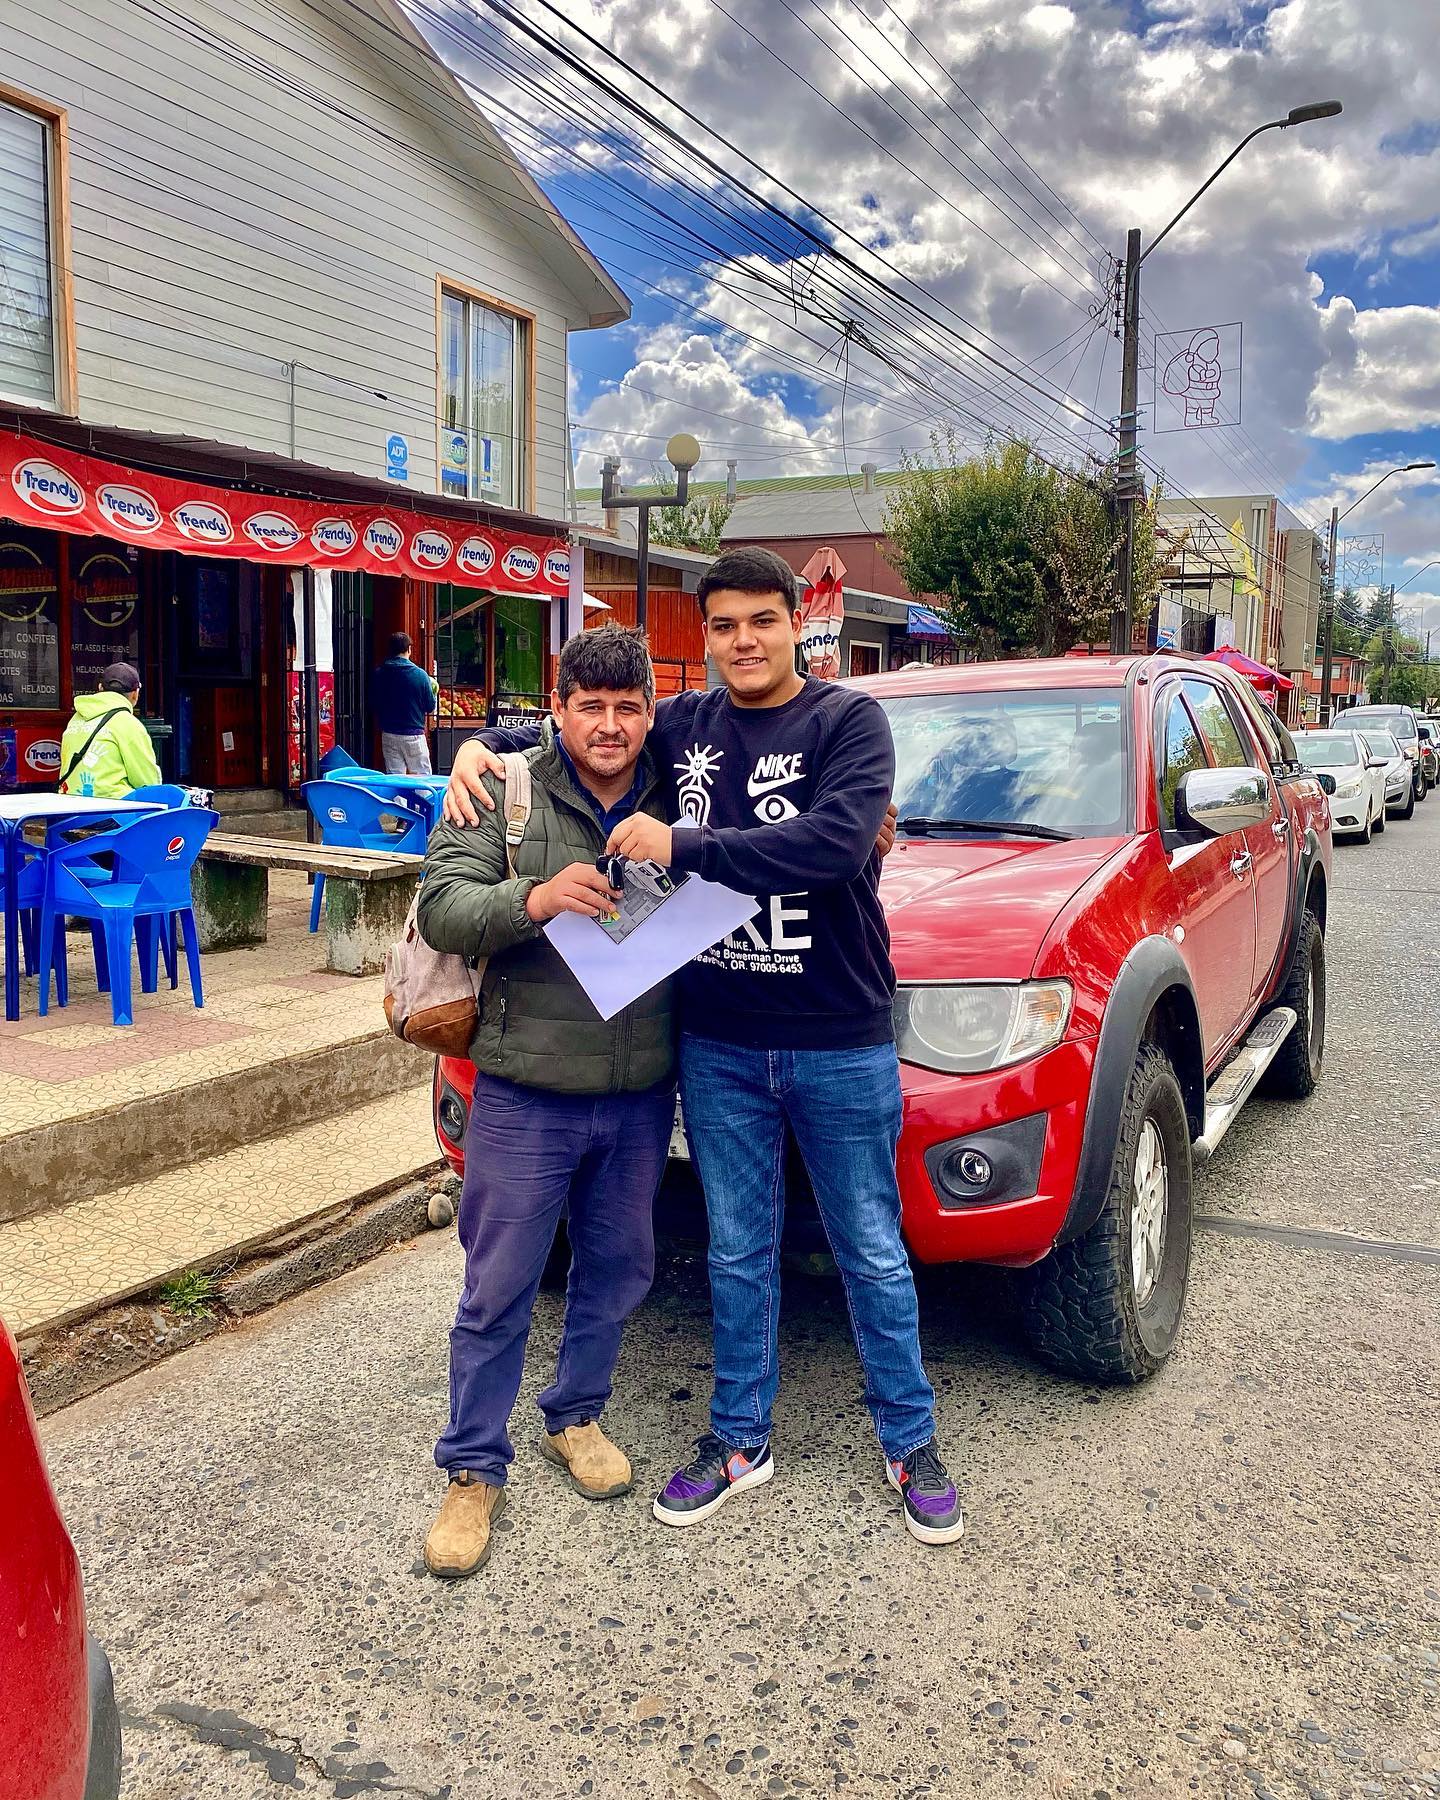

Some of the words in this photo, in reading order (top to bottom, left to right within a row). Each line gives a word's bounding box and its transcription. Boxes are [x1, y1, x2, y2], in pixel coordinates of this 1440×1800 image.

[390, 445, 405, 458] ADT
[24, 470, 79, 504] Trendy
[104, 493, 155, 522] Trendy
[179, 511, 227, 536] Trendy
[250, 523, 299, 541] Trendy
[318, 527, 352, 546] Trendy
[369, 529, 398, 549] Trendy
[417, 539, 449, 559] Trendy
[461, 547, 491, 565] Trendy
[509, 554, 538, 572] Trendy
[548, 559, 570, 573] Trend
[16, 632, 56, 645] CONFITES
[75, 665, 105, 674] HELADOS
[21, 684, 56, 694] HELADOS
[754, 752, 803, 780] NIKE
[723, 949, 772, 963] Bowerman
[774, 953, 800, 963] Drive
[750, 961, 804, 974] 97005-6453
